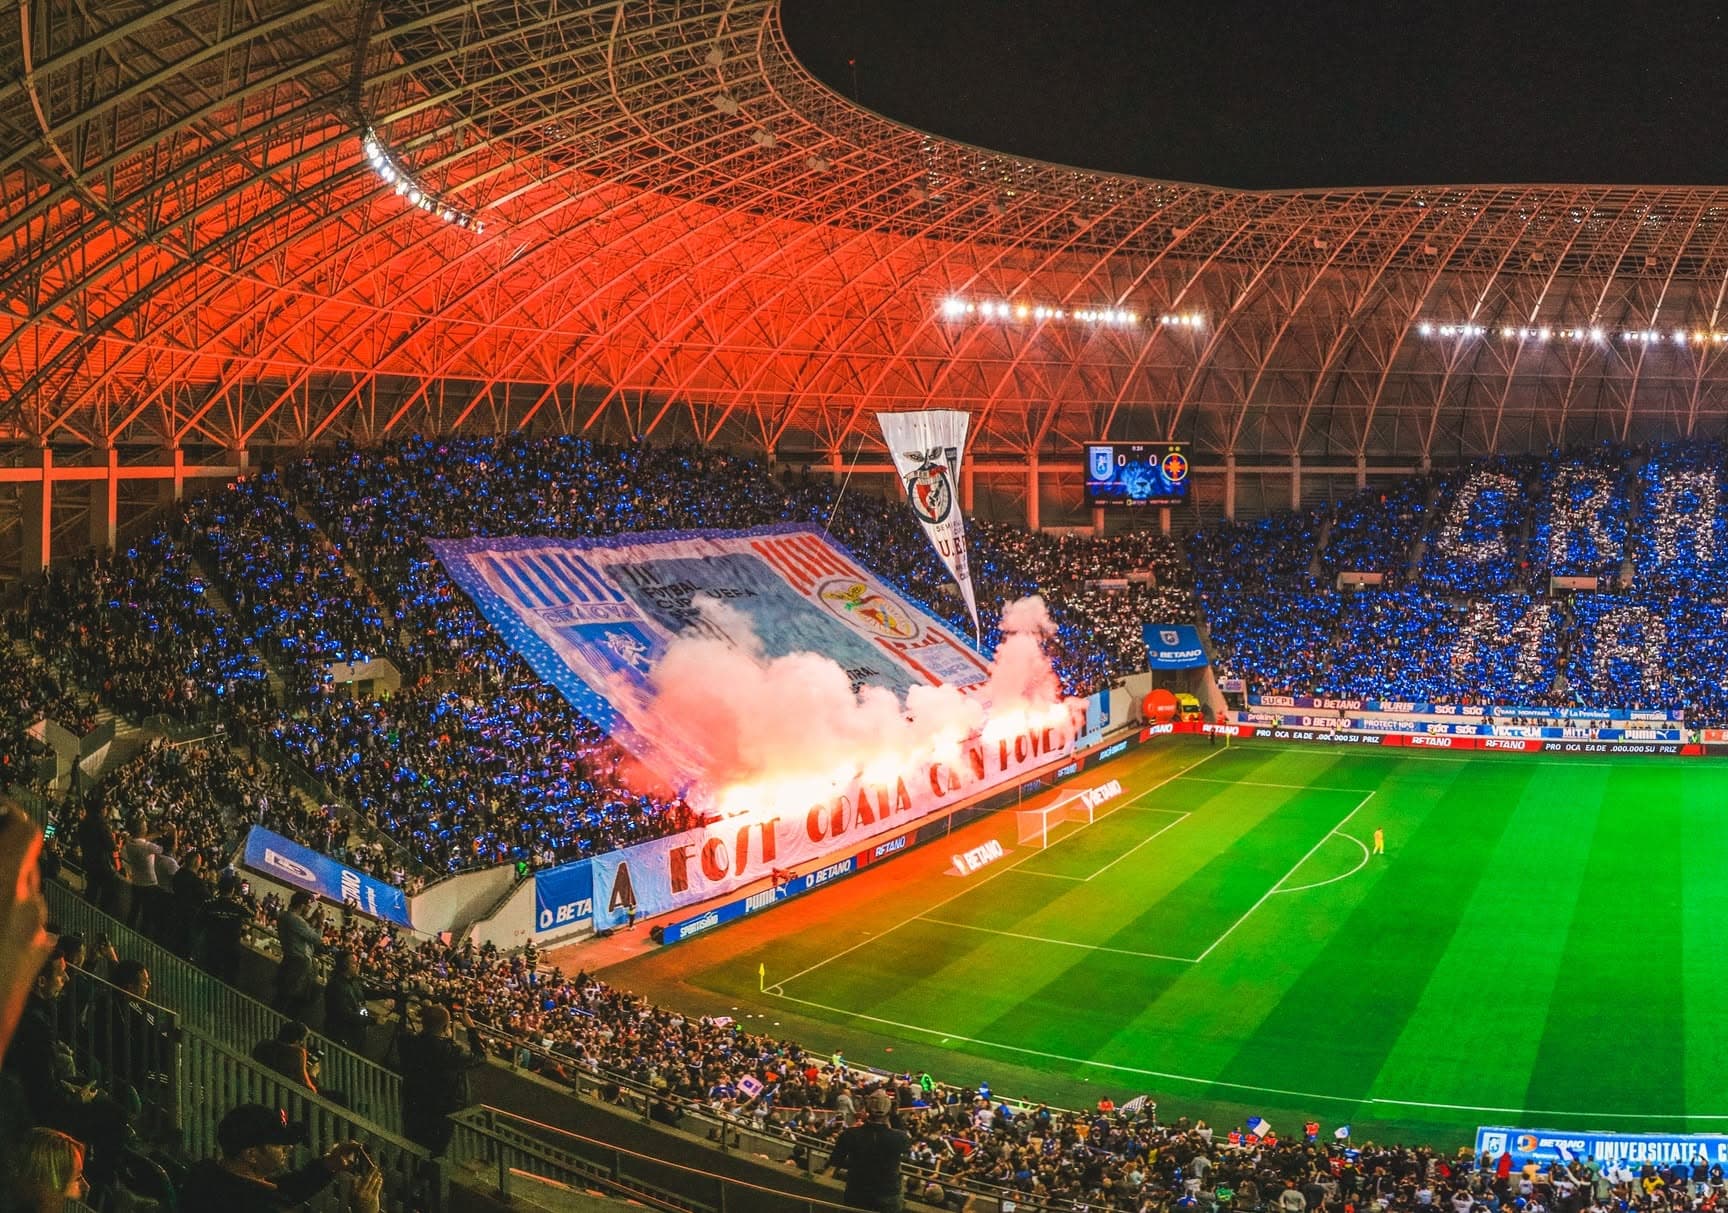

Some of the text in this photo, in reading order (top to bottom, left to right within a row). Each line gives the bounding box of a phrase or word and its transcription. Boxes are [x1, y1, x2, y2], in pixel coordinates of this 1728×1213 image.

[1118, 454, 1126, 466] 0
[1149, 454, 1157, 466] 0
[1159, 649, 1202, 658] BETANO
[1323, 699, 1360, 710] BETANO
[1313, 717, 1351, 728] BETANO
[963, 839, 1004, 871] BETANO
[608, 860, 638, 913] A
[669, 816, 780, 895] FOST
[815, 859, 851, 883] BETANO
[745, 888, 776, 913] PUMA
[556, 897, 592, 924] BETA
[1539, 1139, 1585, 1149] BETANO
[1595, 1140, 1707, 1162] UNIVERSITATEA
